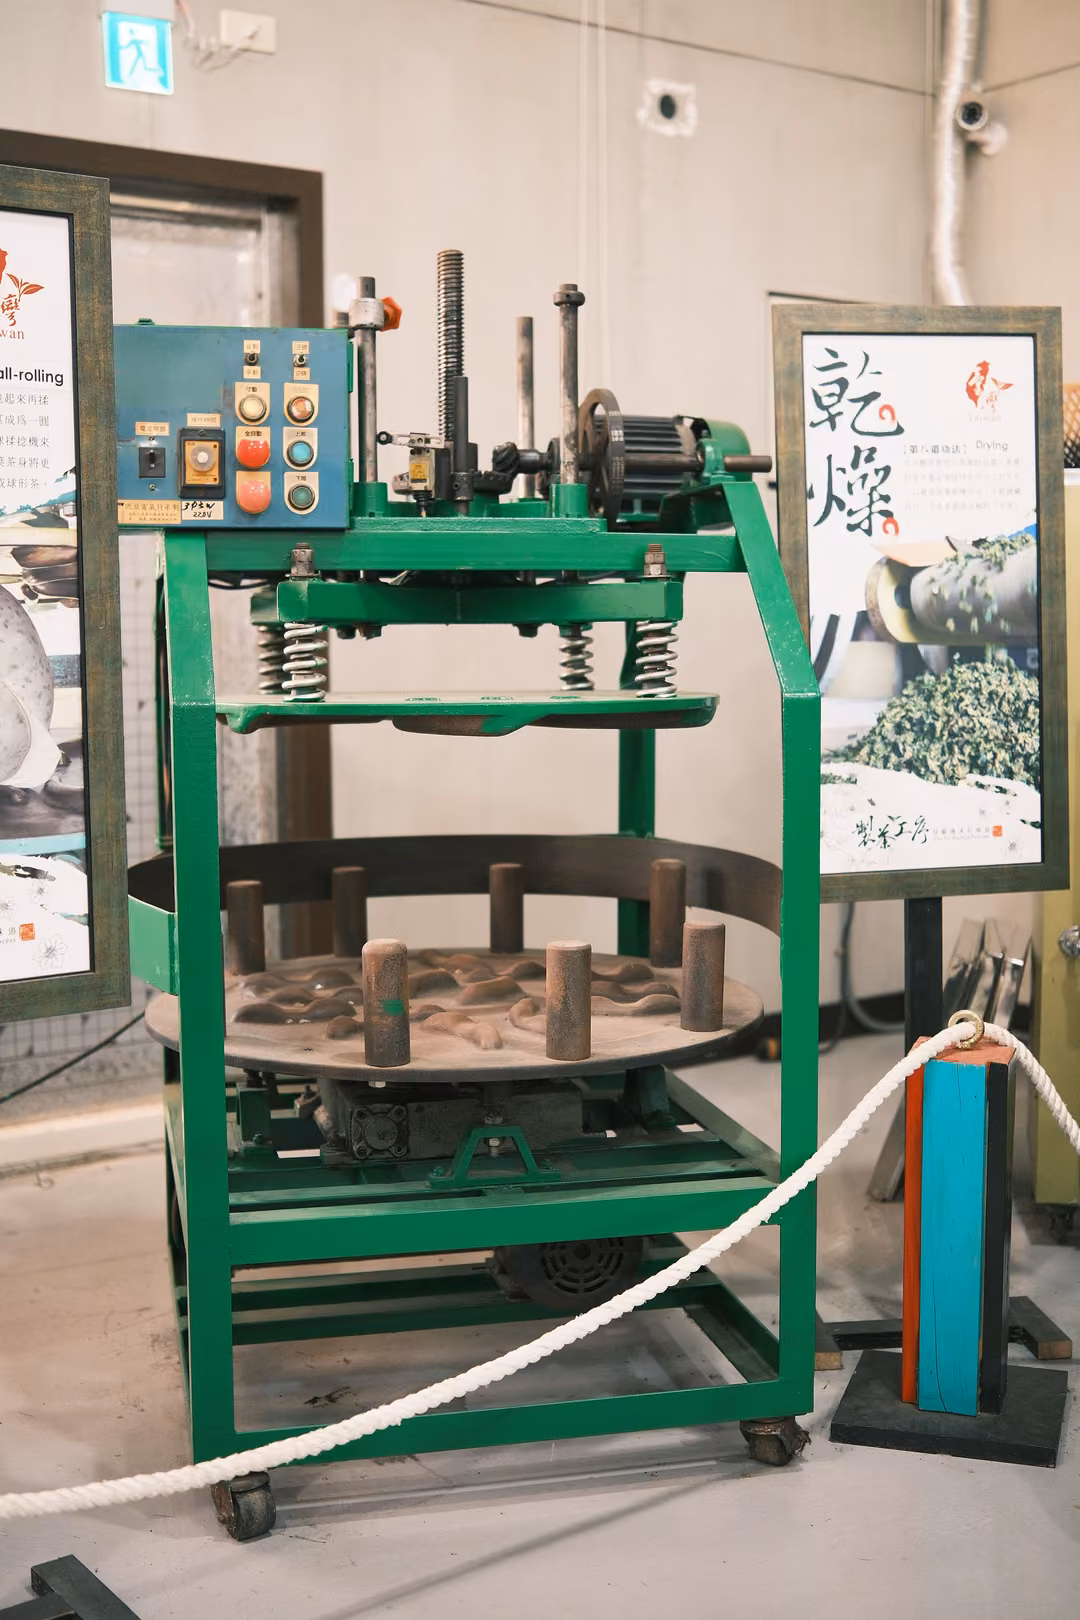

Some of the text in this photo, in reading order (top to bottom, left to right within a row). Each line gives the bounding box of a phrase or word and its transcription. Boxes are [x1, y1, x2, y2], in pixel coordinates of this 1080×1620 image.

[0, 393, 49, 406] 起來再揉
[975, 440, 1009, 451] Drying
